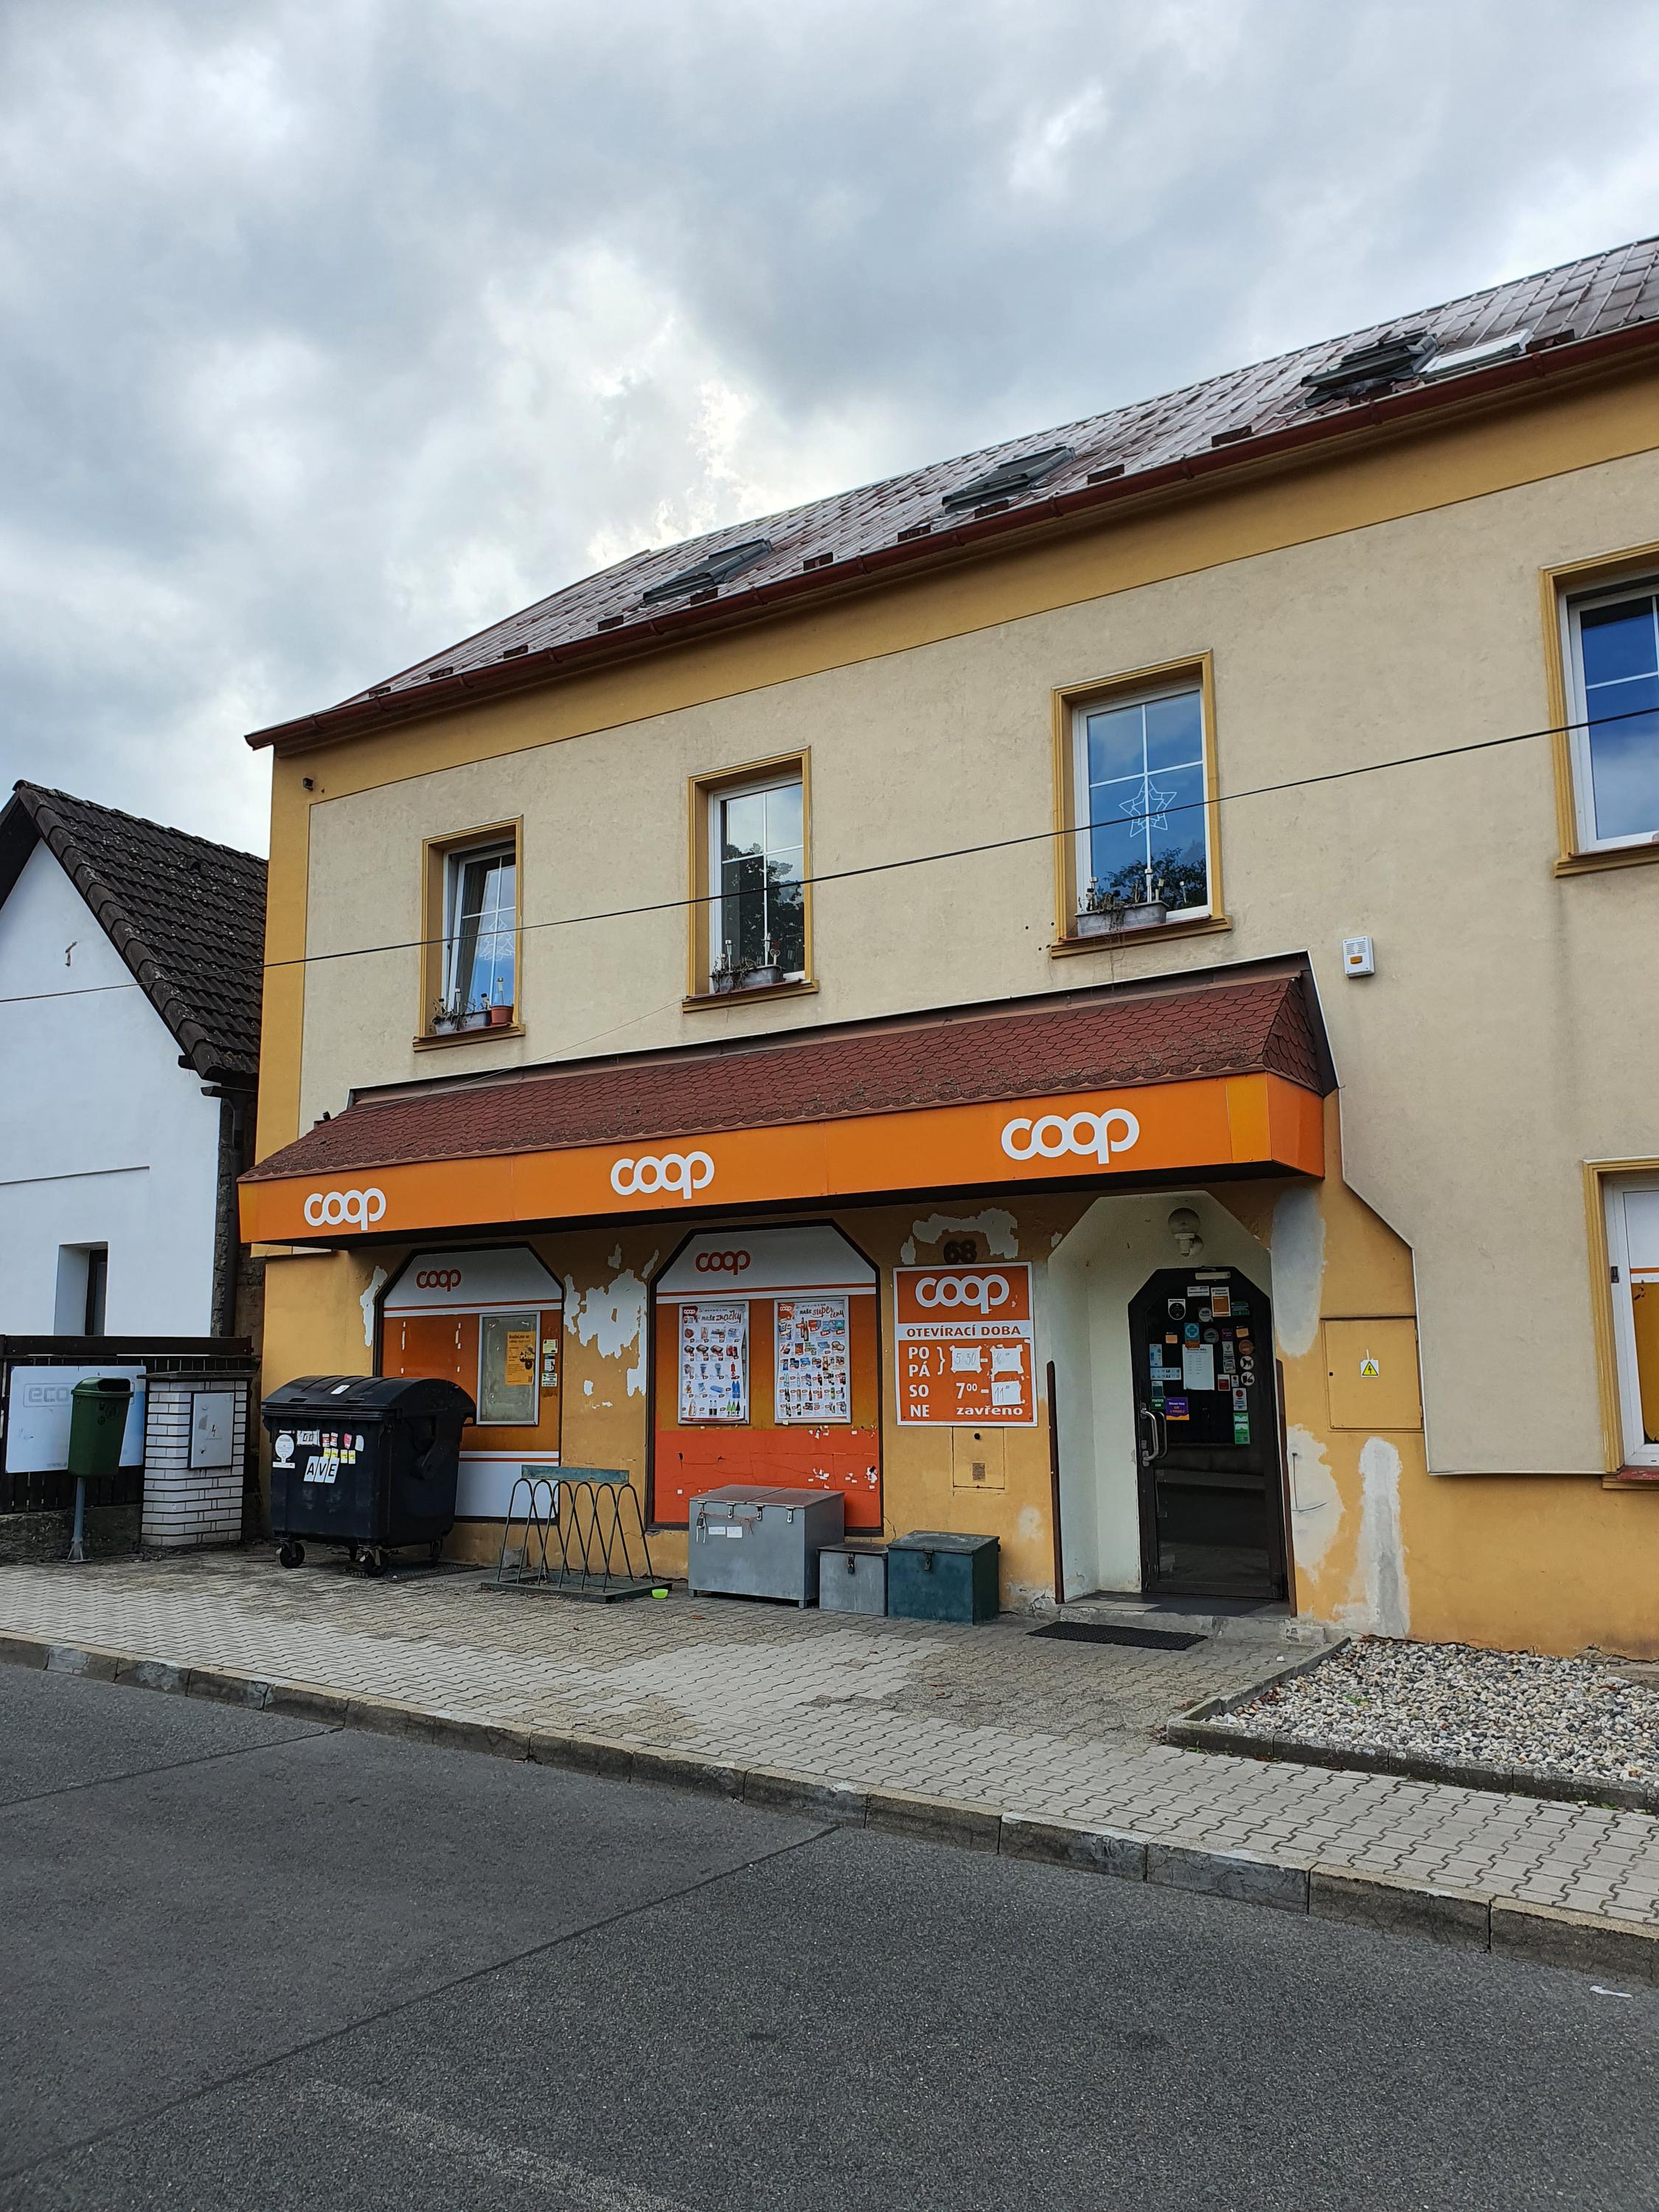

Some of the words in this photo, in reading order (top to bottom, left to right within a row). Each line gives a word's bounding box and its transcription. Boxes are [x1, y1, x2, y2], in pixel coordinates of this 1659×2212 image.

[1001, 1108, 1140, 1164] coop
[611, 1151, 714, 1200] coop
[304, 1188, 386, 1231] coop
[695, 1251, 751, 1275] coop
[416, 1269, 461, 1292] coop
[915, 1274, 1009, 1314] coop
[715, 1310, 741, 1324] značky
[813, 1306, 834, 1317] super
[907, 1324, 975, 1337] OTEVÍRACÍ
[981, 1326, 1020, 1336] DOBA
[908, 1346, 930, 1360] PO
[908, 1363, 931, 1377] PÁ
[909, 1385, 929, 1397] SO
[910, 1405, 930, 1417] NE
[956, 1405, 1023, 1416] zavřeno
[307, 1462, 337, 1477] AVE
